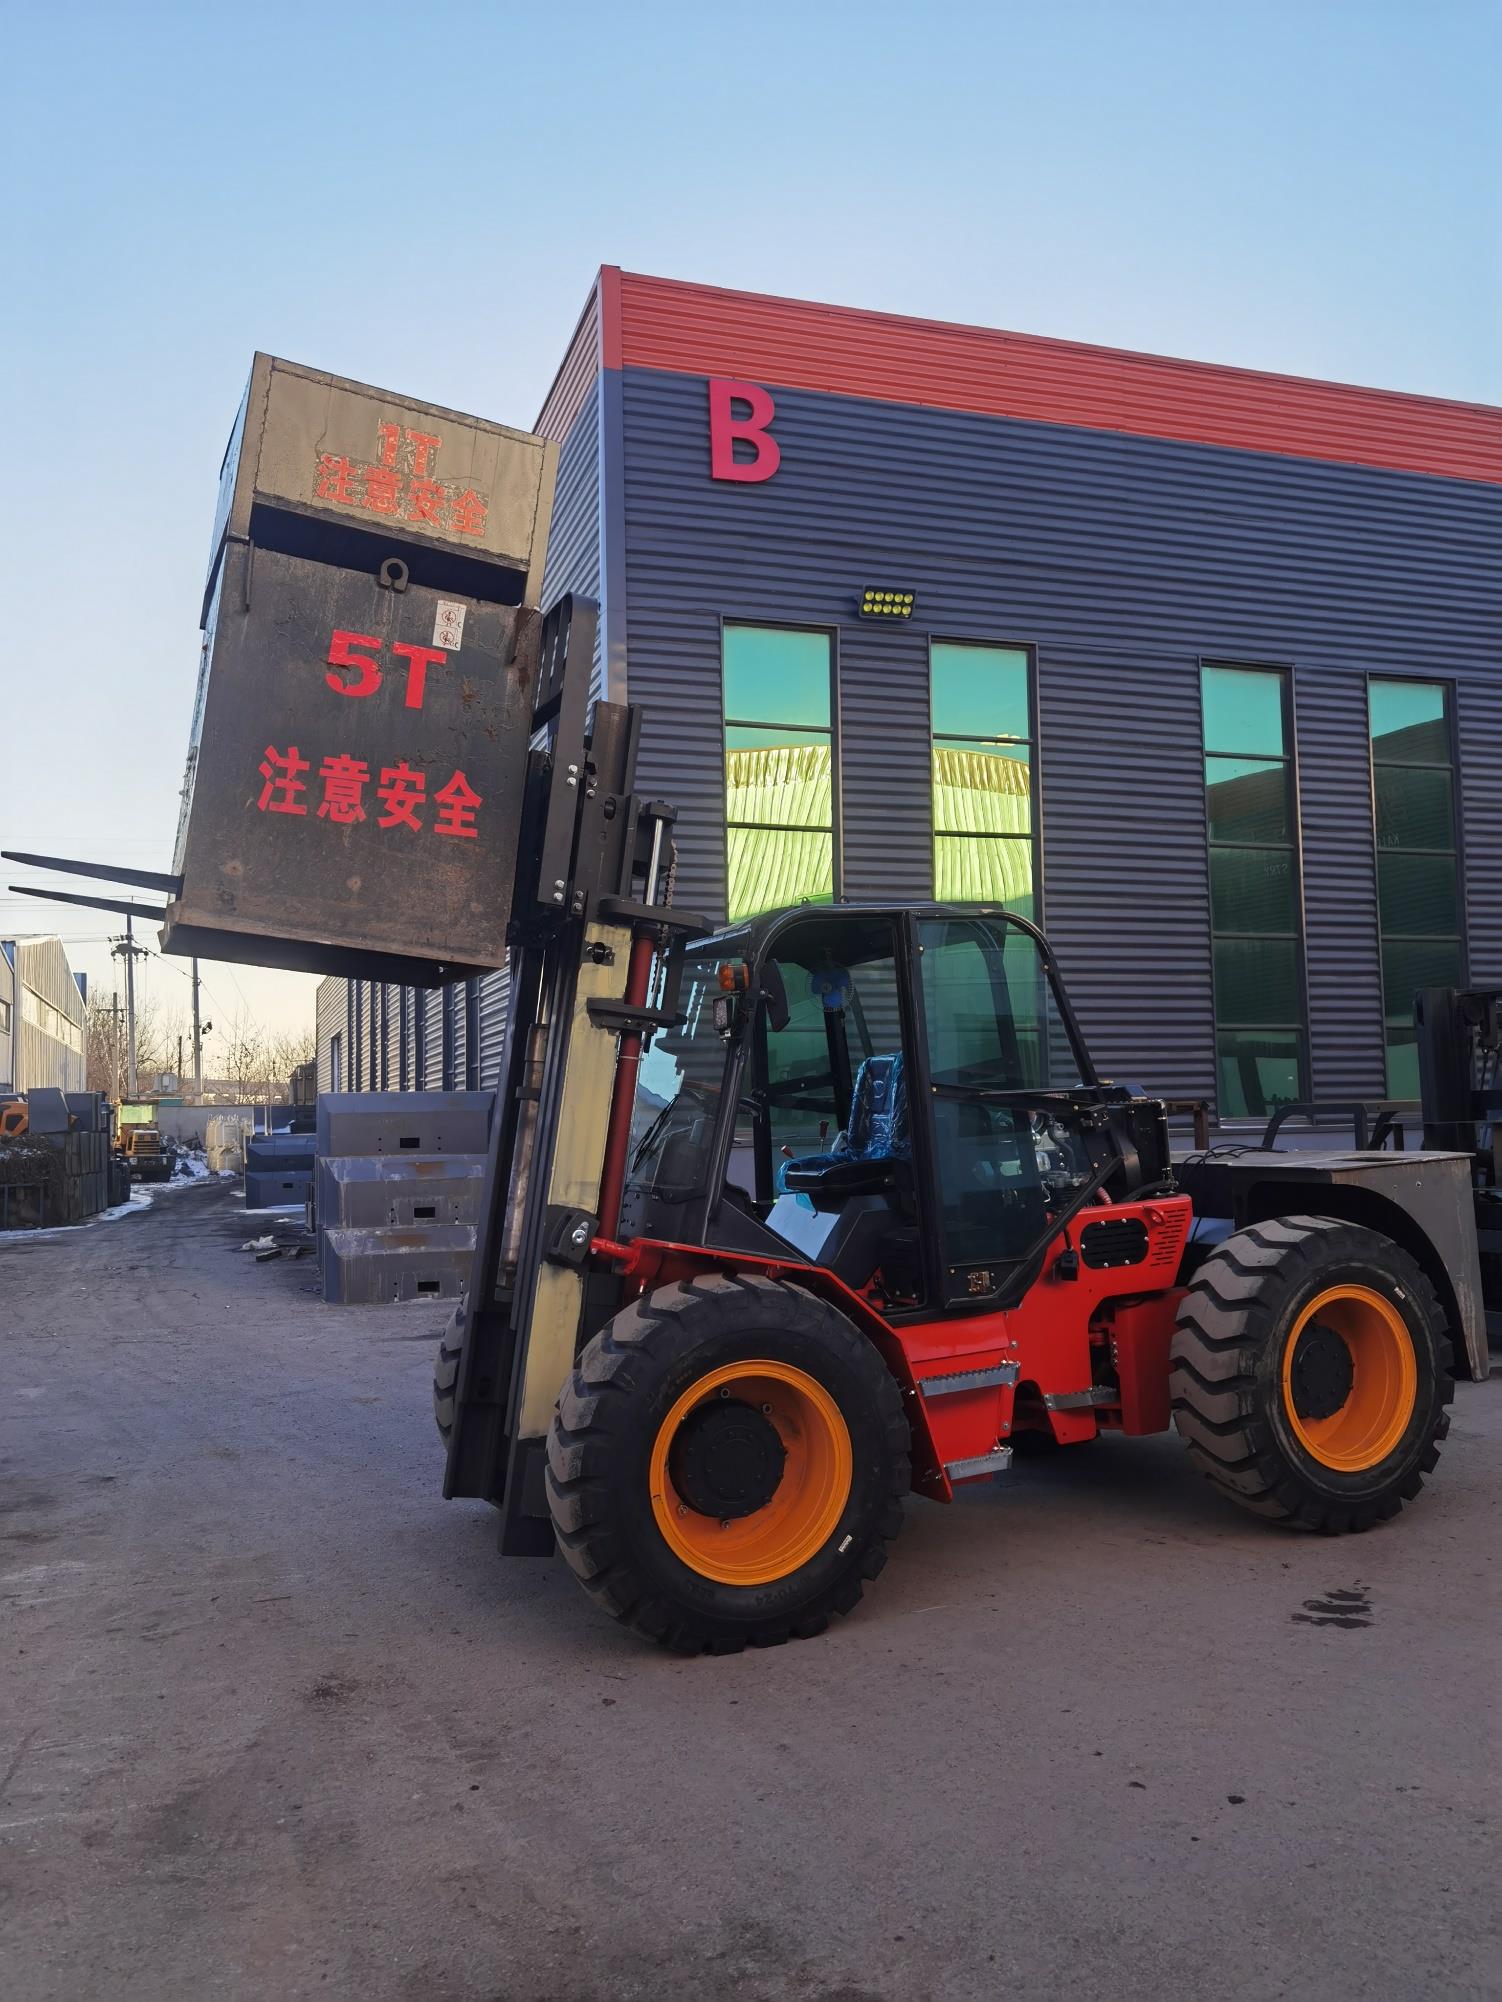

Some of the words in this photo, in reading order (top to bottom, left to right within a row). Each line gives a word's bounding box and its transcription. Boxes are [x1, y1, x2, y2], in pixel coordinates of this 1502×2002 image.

[379, 423, 442, 476] 1T
[708, 377, 781, 484] B
[317, 453, 489, 537] 注意安全
[325, 629, 448, 710] 5T
[257, 744, 483, 838] 注意安全
